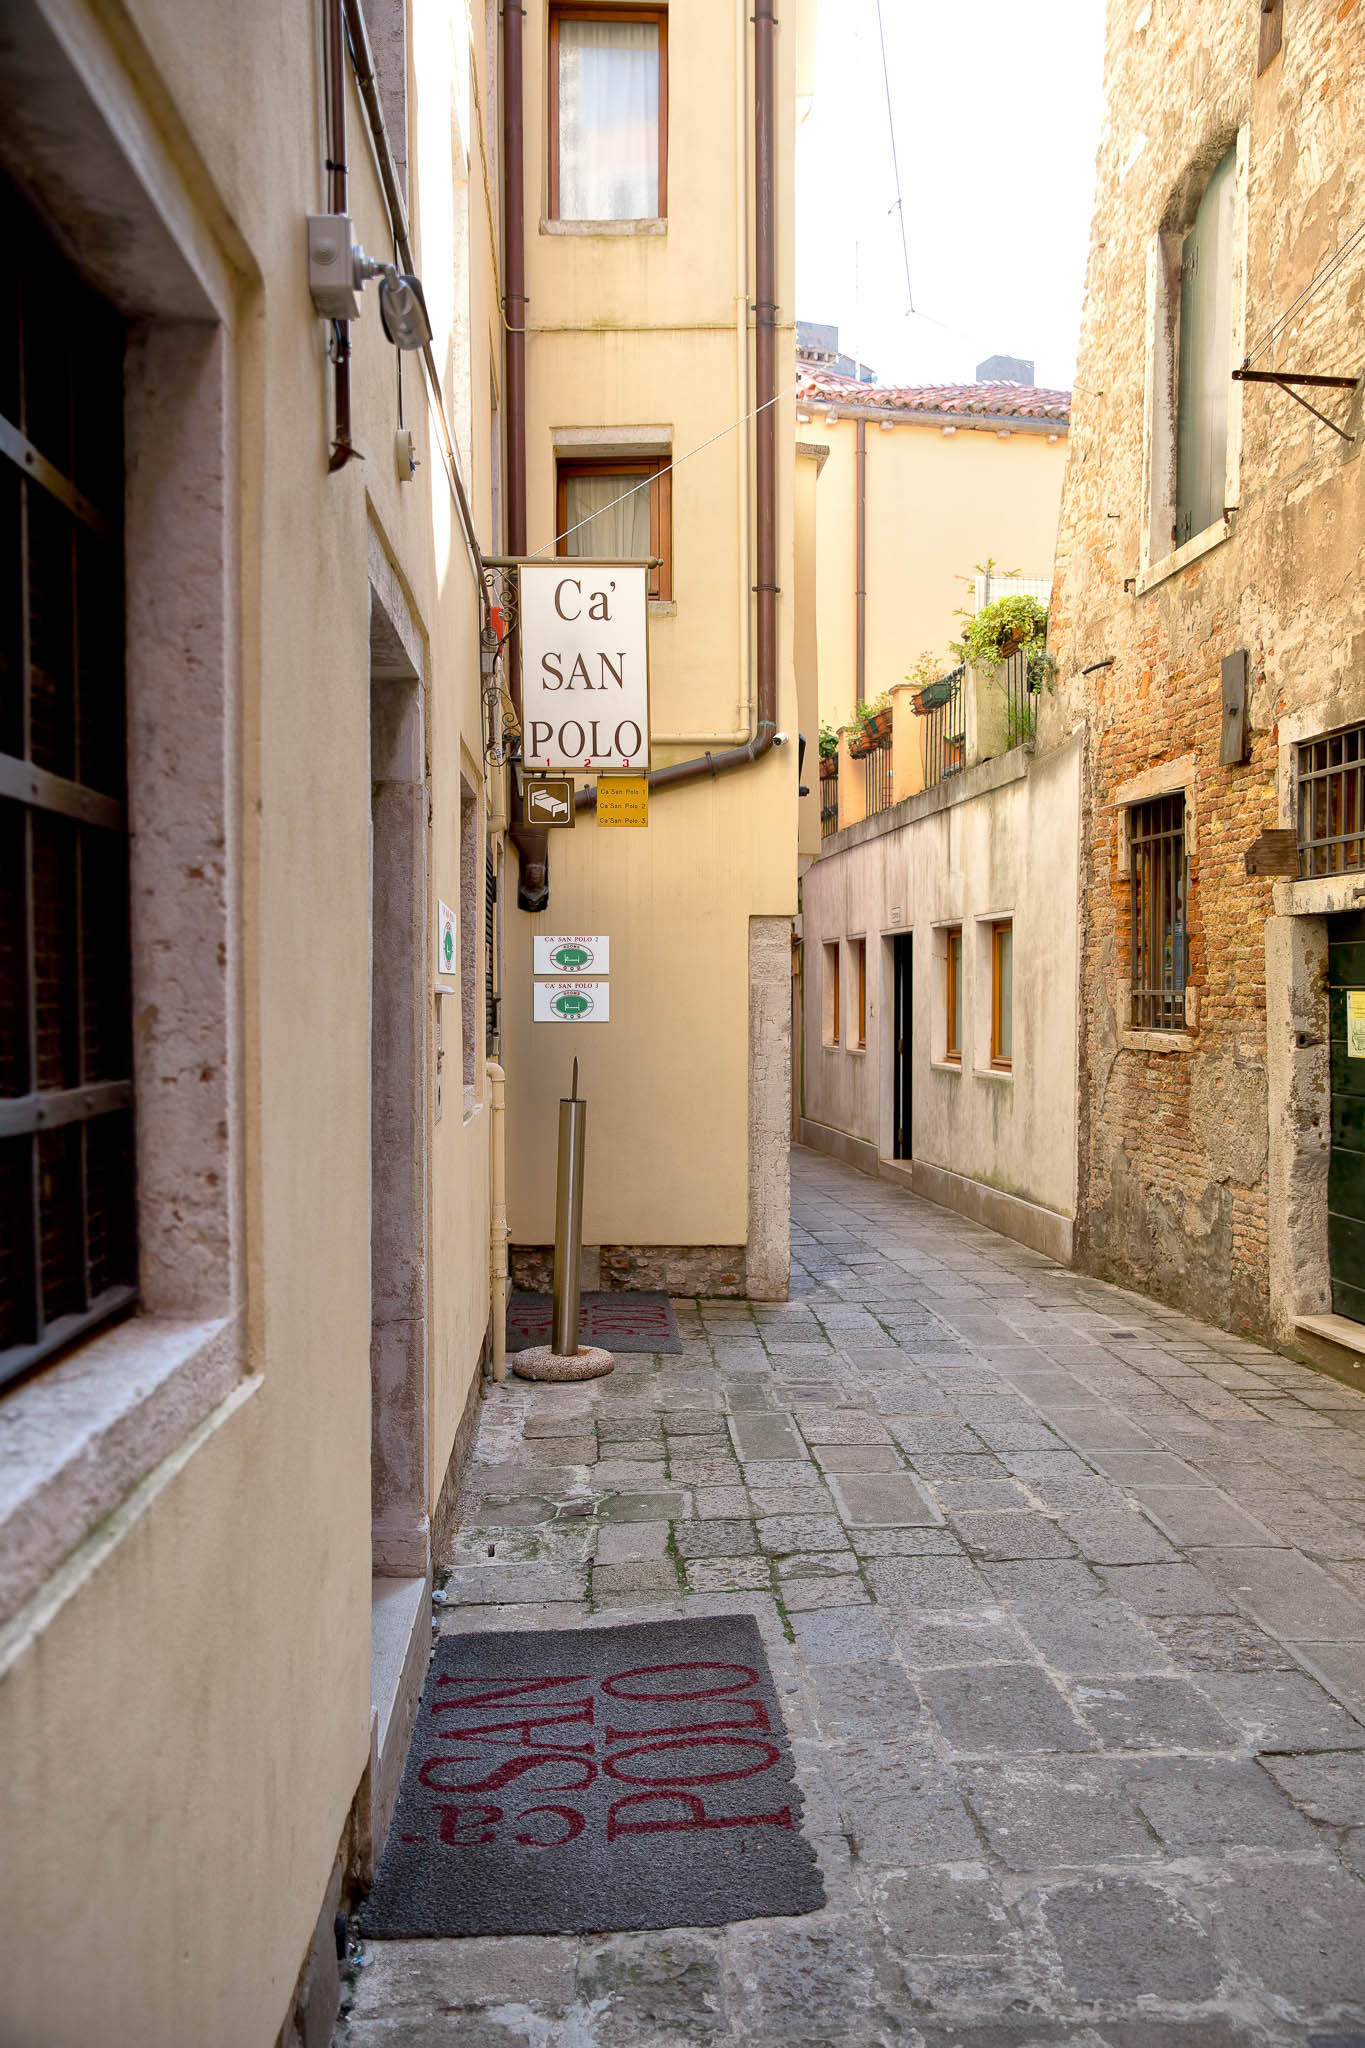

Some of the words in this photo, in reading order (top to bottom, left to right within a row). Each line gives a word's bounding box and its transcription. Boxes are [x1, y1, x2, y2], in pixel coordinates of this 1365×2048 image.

[554, 578, 616, 622] Ca'
[541, 652, 627, 691] SAN
[528, 720, 642, 758] POLO
[546, 758, 551, 767] 1
[584, 758, 592, 768] 2
[622, 758, 630, 768] 3
[417, 1673, 600, 1794] SAN
[600, 1660, 795, 1843] POLO
